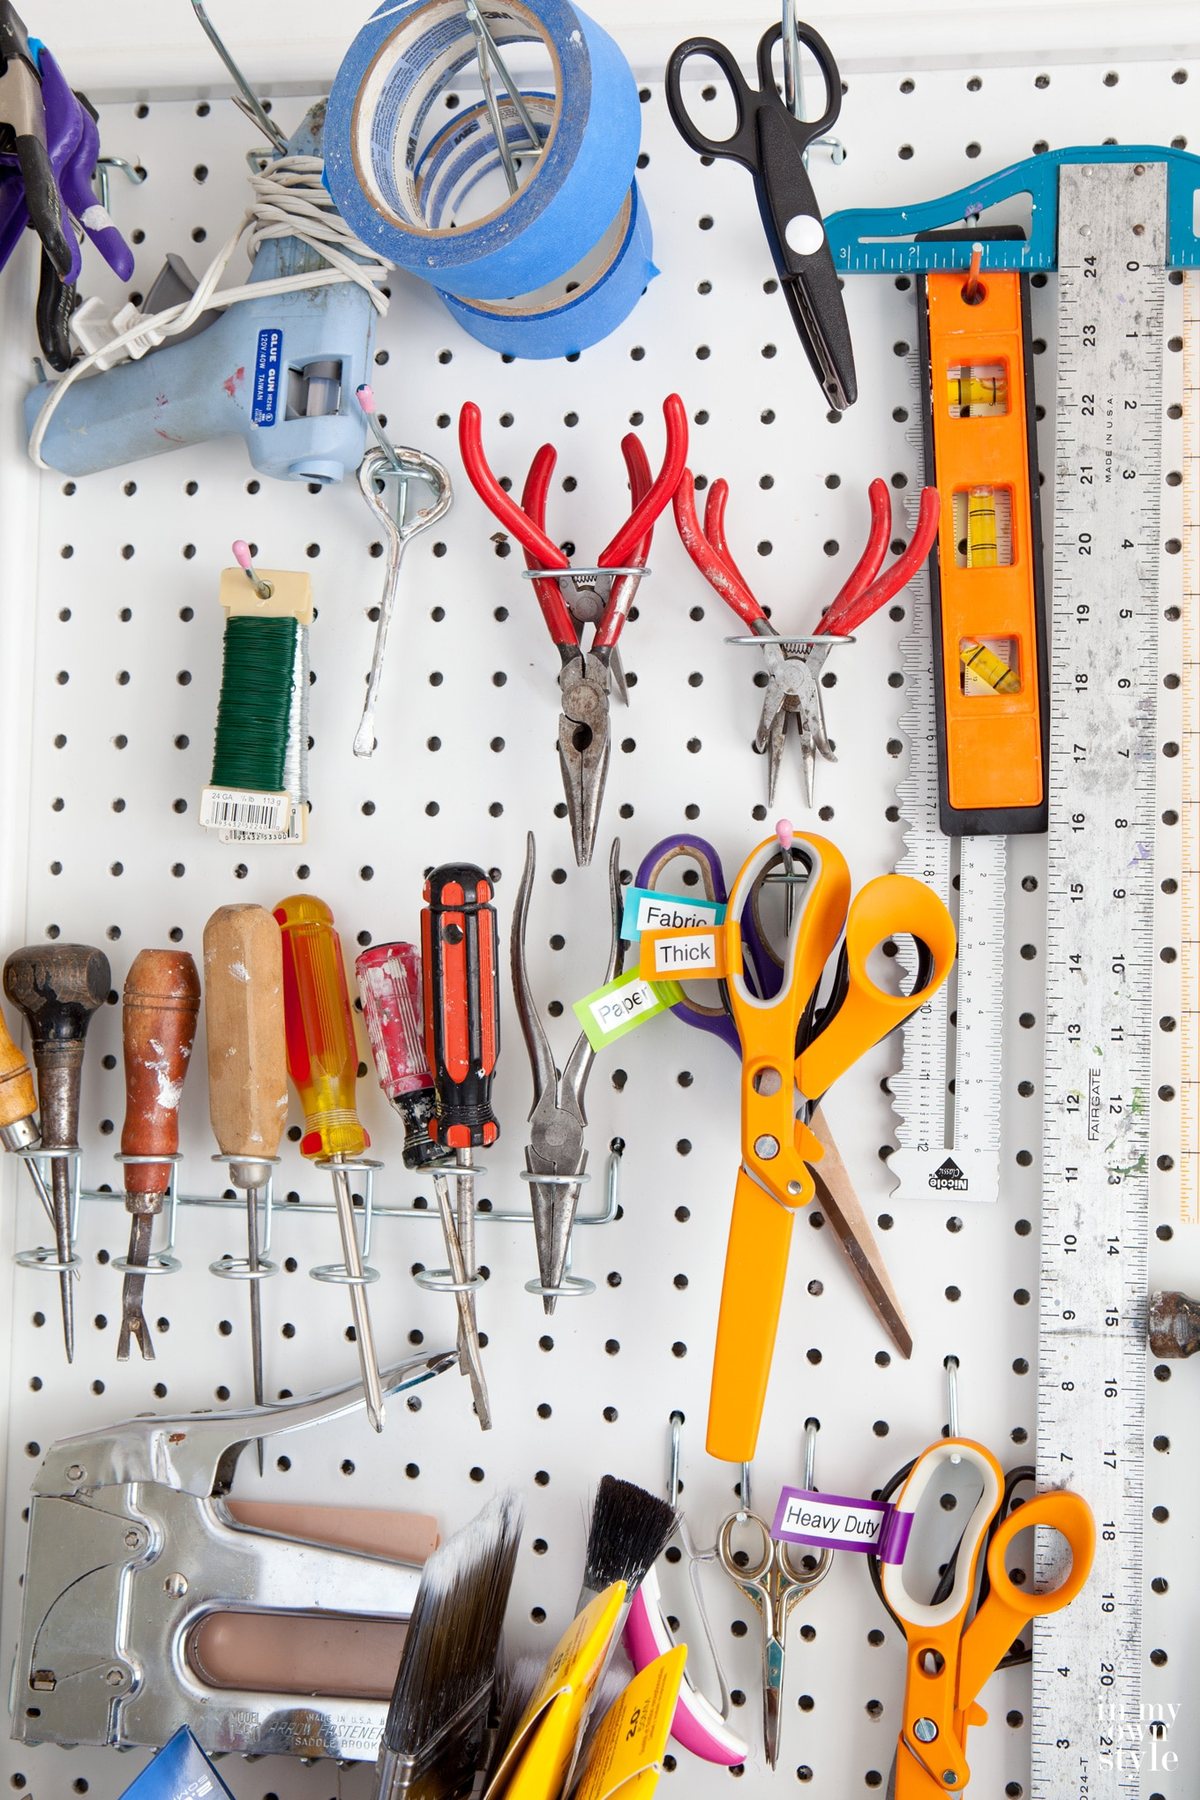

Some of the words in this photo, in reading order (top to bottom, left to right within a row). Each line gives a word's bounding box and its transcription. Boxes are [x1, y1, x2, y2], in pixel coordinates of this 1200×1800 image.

[482, 11, 513, 20] 3M
[454, 120, 479, 146] 3M
[405, 137, 418, 171] 3M
[840, 248, 847, 258] 3
[1084, 256, 1096, 278] 24
[1126, 261, 1139, 271] 0
[1083, 325, 1095, 346] 23
[269, 334, 278, 362] GLUE
[257, 374, 265, 401] TAIWAN
[267, 368, 276, 392] GUN
[1082, 395, 1094, 415] 22
[1125, 401, 1137, 410] 2
[1106, 433, 1112, 445] IN
[1080, 467, 1093, 485] 21
[1105, 450, 1113, 483] MADE
[1123, 470, 1136, 479] 3
[1079, 533, 1091, 555] 20
[1121, 539, 1134, 549] 4
[1077, 605, 1089, 624] 19
[1120, 609, 1132, 618] 5
[1075, 674, 1088, 693] 18
[1118, 679, 1131, 688] 6
[1074, 744, 1086, 763] 17
[1117, 749, 1129, 758] 7
[1072, 813, 1085, 833] 16
[1115, 819, 1127, 828] 8
[1071, 884, 1083, 903] 15
[1113, 889, 1126, 899] 9
[647, 906, 708, 928] Fabric
[660, 942, 711, 963] Thick
[1069, 954, 1081, 973] 14
[1112, 954, 1125, 973] 10
[598, 986, 649, 1024] Paper
[920, 1004, 932, 1014] 10
[1068, 1024, 1081, 1043] 13
[1111, 1026, 1123, 1042] 11
[918, 1073, 930, 1081] 11
[1067, 1095, 1079, 1114] 12
[1087, 1068, 1101, 1141] FAIRGATE
[1109, 1095, 1122, 1113] 12
[917, 1142, 929, 1152] 12
[938, 1168, 960, 1179] Classic
[1066, 1167, 1078, 1183] 11
[928, 1177, 968, 1190] Nicole
[1064, 1235, 1077, 1254] 10
[1107, 1235, 1119, 1256] 14
[1063, 1310, 1075, 1320] 9
[1105, 1307, 1118, 1326] 15
[1062, 1382, 1074, 1391] 8
[1105, 1378, 1117, 1397] 16
[1061, 1453, 1073, 1462] 7
[1104, 1450, 1116, 1469] 17
[787, 1506, 841, 1533] Heavy
[844, 1515, 880, 1538] Duty
[1103, 1521, 1115, 1540] 18
[1102, 1593, 1114, 1612] 19
[1057, 1667, 1070, 1677] 4
[1101, 1663, 1114, 1686] 20
[306, 1713, 332, 1723] MADE
[337, 1715, 346, 1723] IN
[270, 1722, 312, 1737] ARROW
[295, 1737, 336, 1748] SADDLE
[341, 1738, 378, 1749] BROOK
[1056, 1739, 1070, 1749] 3
